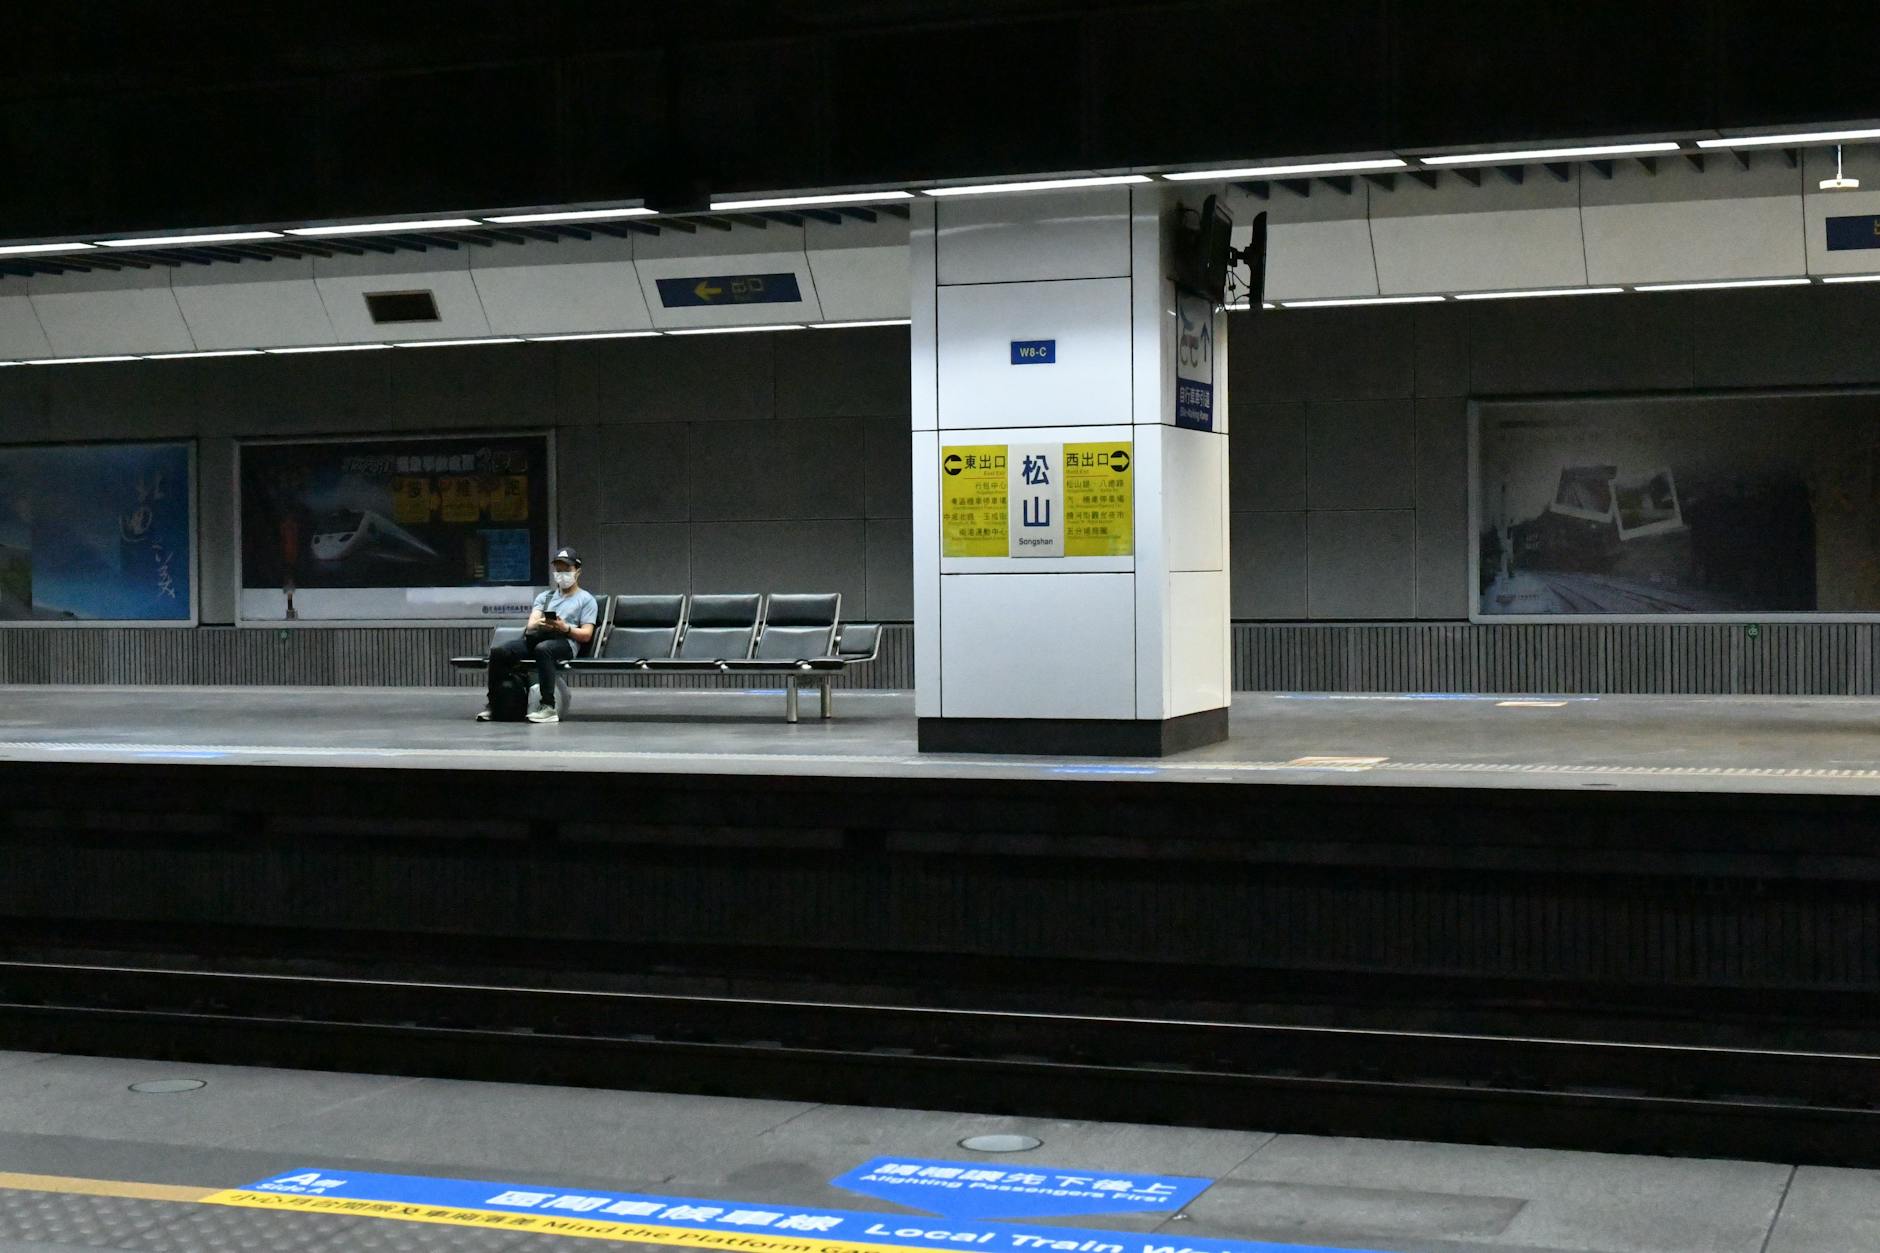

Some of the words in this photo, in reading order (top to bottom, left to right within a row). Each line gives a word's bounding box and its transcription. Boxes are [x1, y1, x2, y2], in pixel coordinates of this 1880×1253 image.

[1020, 347, 1047, 357] W8-C
[965, 455, 1006, 469] 東出口
[1066, 452, 1109, 467] 西出口
[1022, 455, 1050, 526] 松山
[1019, 538, 1053, 547] Songshan
[860, 1174, 964, 1189] Alighting
[969, 1182, 1105, 1198] Passengers
[1112, 1192, 1168, 1203] First
[485, 1190, 844, 1232] 區間車候車線
[542, 1220, 617, 1234] Mind
[621, 1227, 671, 1240] the
[678, 1233, 812, 1251] Platform
[864, 1224, 995, 1245] Local
[1011, 1234, 1124, 1253] Train
